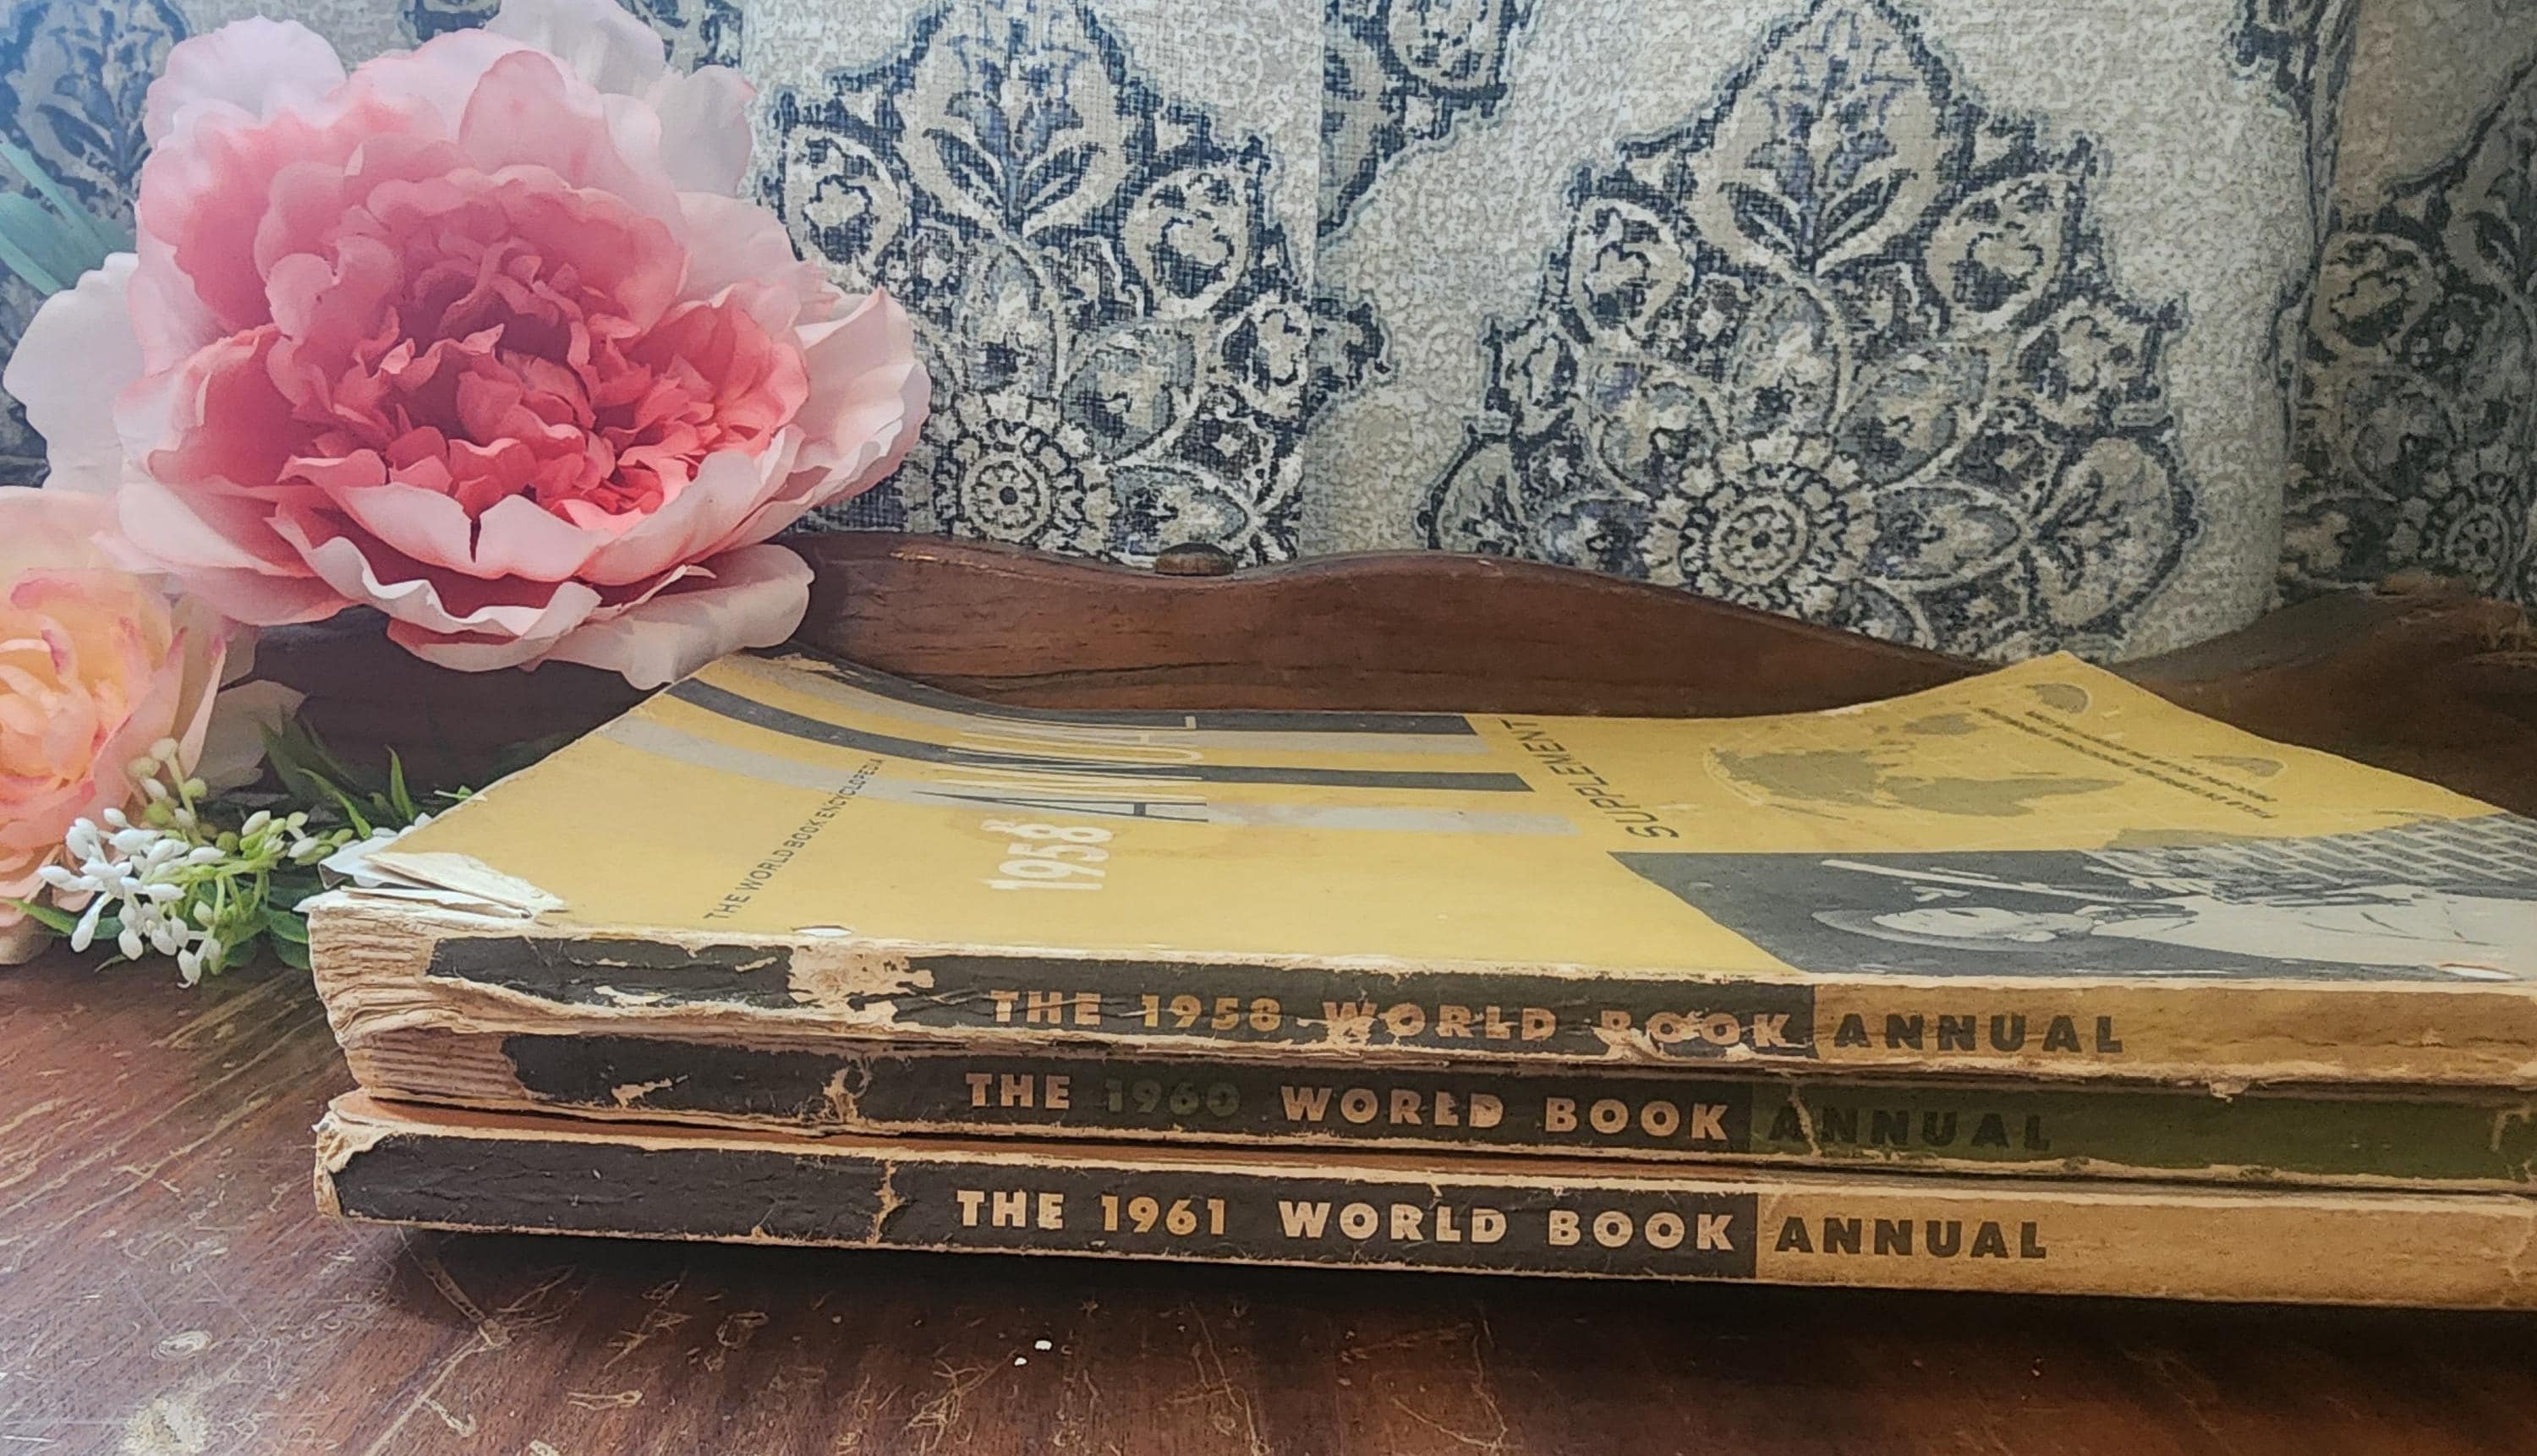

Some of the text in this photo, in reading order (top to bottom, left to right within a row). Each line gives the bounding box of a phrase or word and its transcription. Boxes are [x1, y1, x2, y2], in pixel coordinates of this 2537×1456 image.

[1501, 719, 1679, 839] SUPPLEMENT
[703, 894, 751, 919] THE
[734, 849, 795, 890] WORLD
[783, 818, 827, 849] BOOK
[979, 819, 1114, 890] 1958
[989, 989, 2123, 1054] THE 1958 WORLD BOOK ANNUAL
[966, 1072, 2051, 1152] THE 1960 WORLD BOOK ANNUAL
[956, 1190, 2047, 1260] THE 1961 WORLD BOOK ANNUAL
